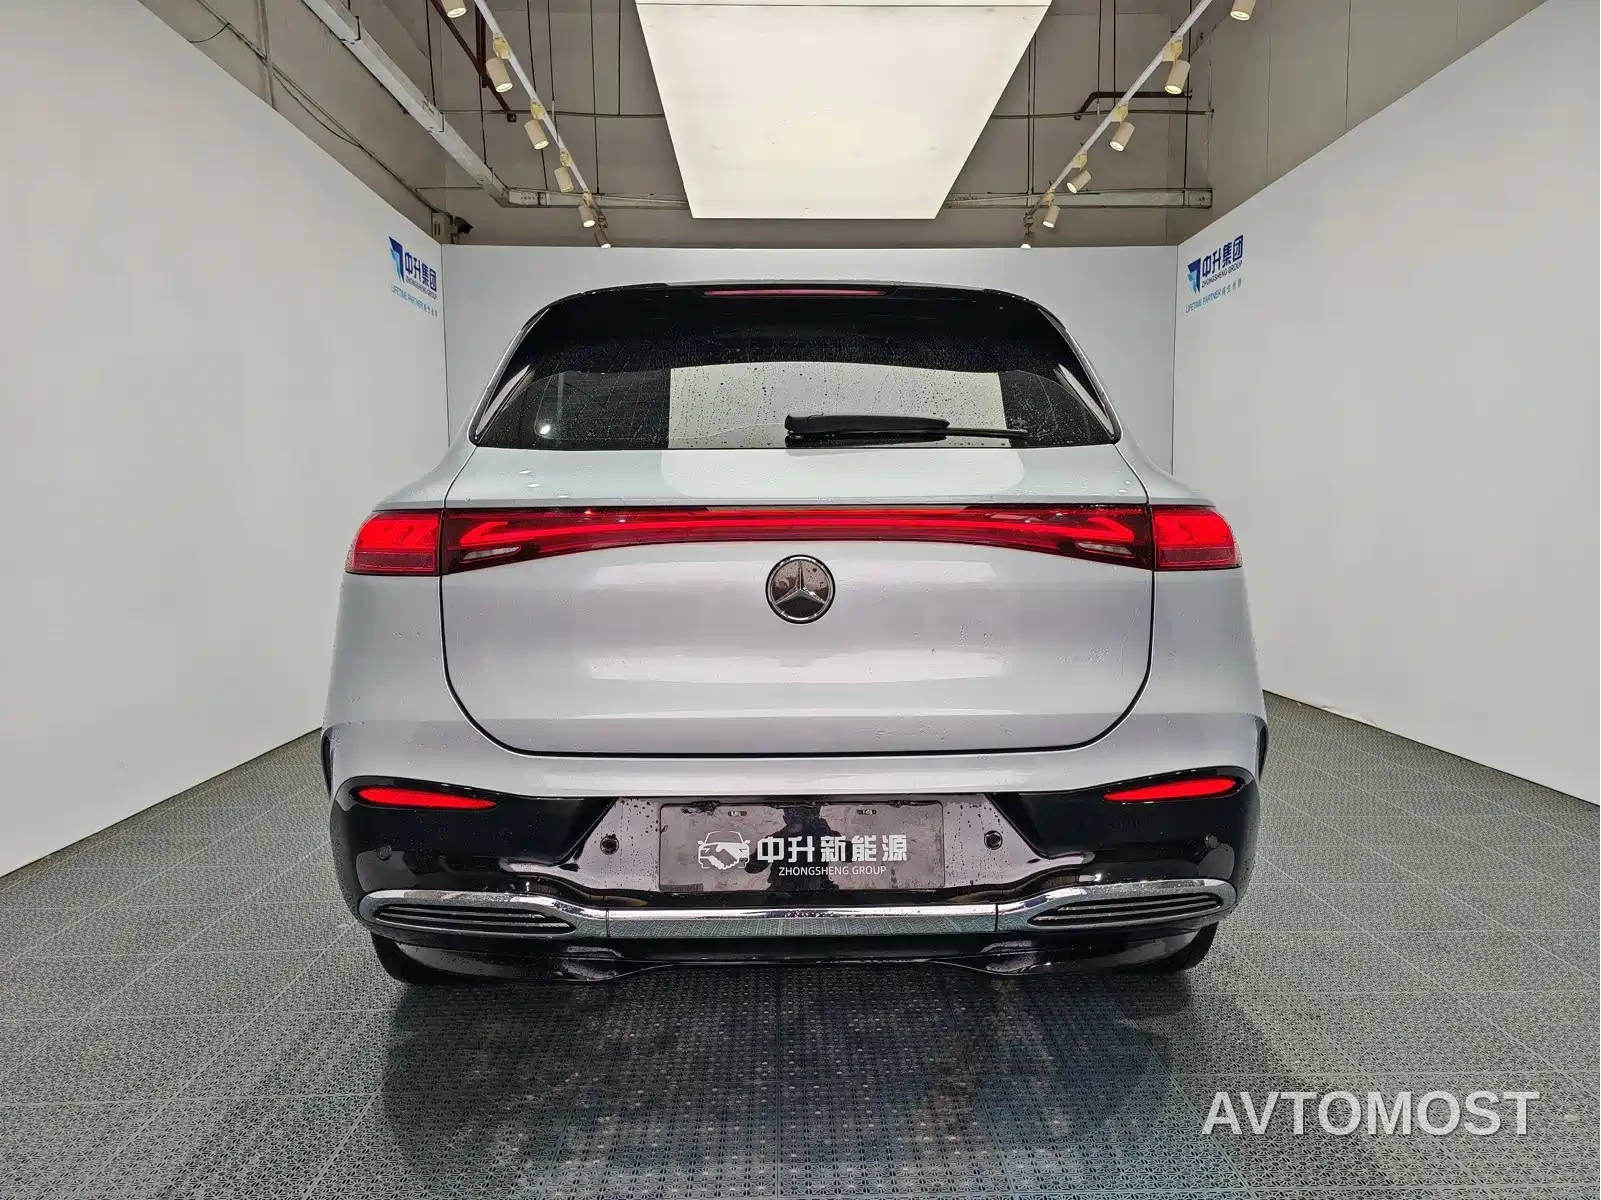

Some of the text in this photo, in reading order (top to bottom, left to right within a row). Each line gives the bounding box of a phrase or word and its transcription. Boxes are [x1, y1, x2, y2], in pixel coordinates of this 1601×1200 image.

[1202, 234, 1243, 277] 中升集团
[404, 252, 437, 292] 中升集团
[1201, 268, 1228, 288] ZHONGSHENG
[1228, 259, 1243, 274] GROUP
[756, 834, 908, 863] 中升新能源
[778, 865, 887, 876] ZHONGSHENG GROUP
